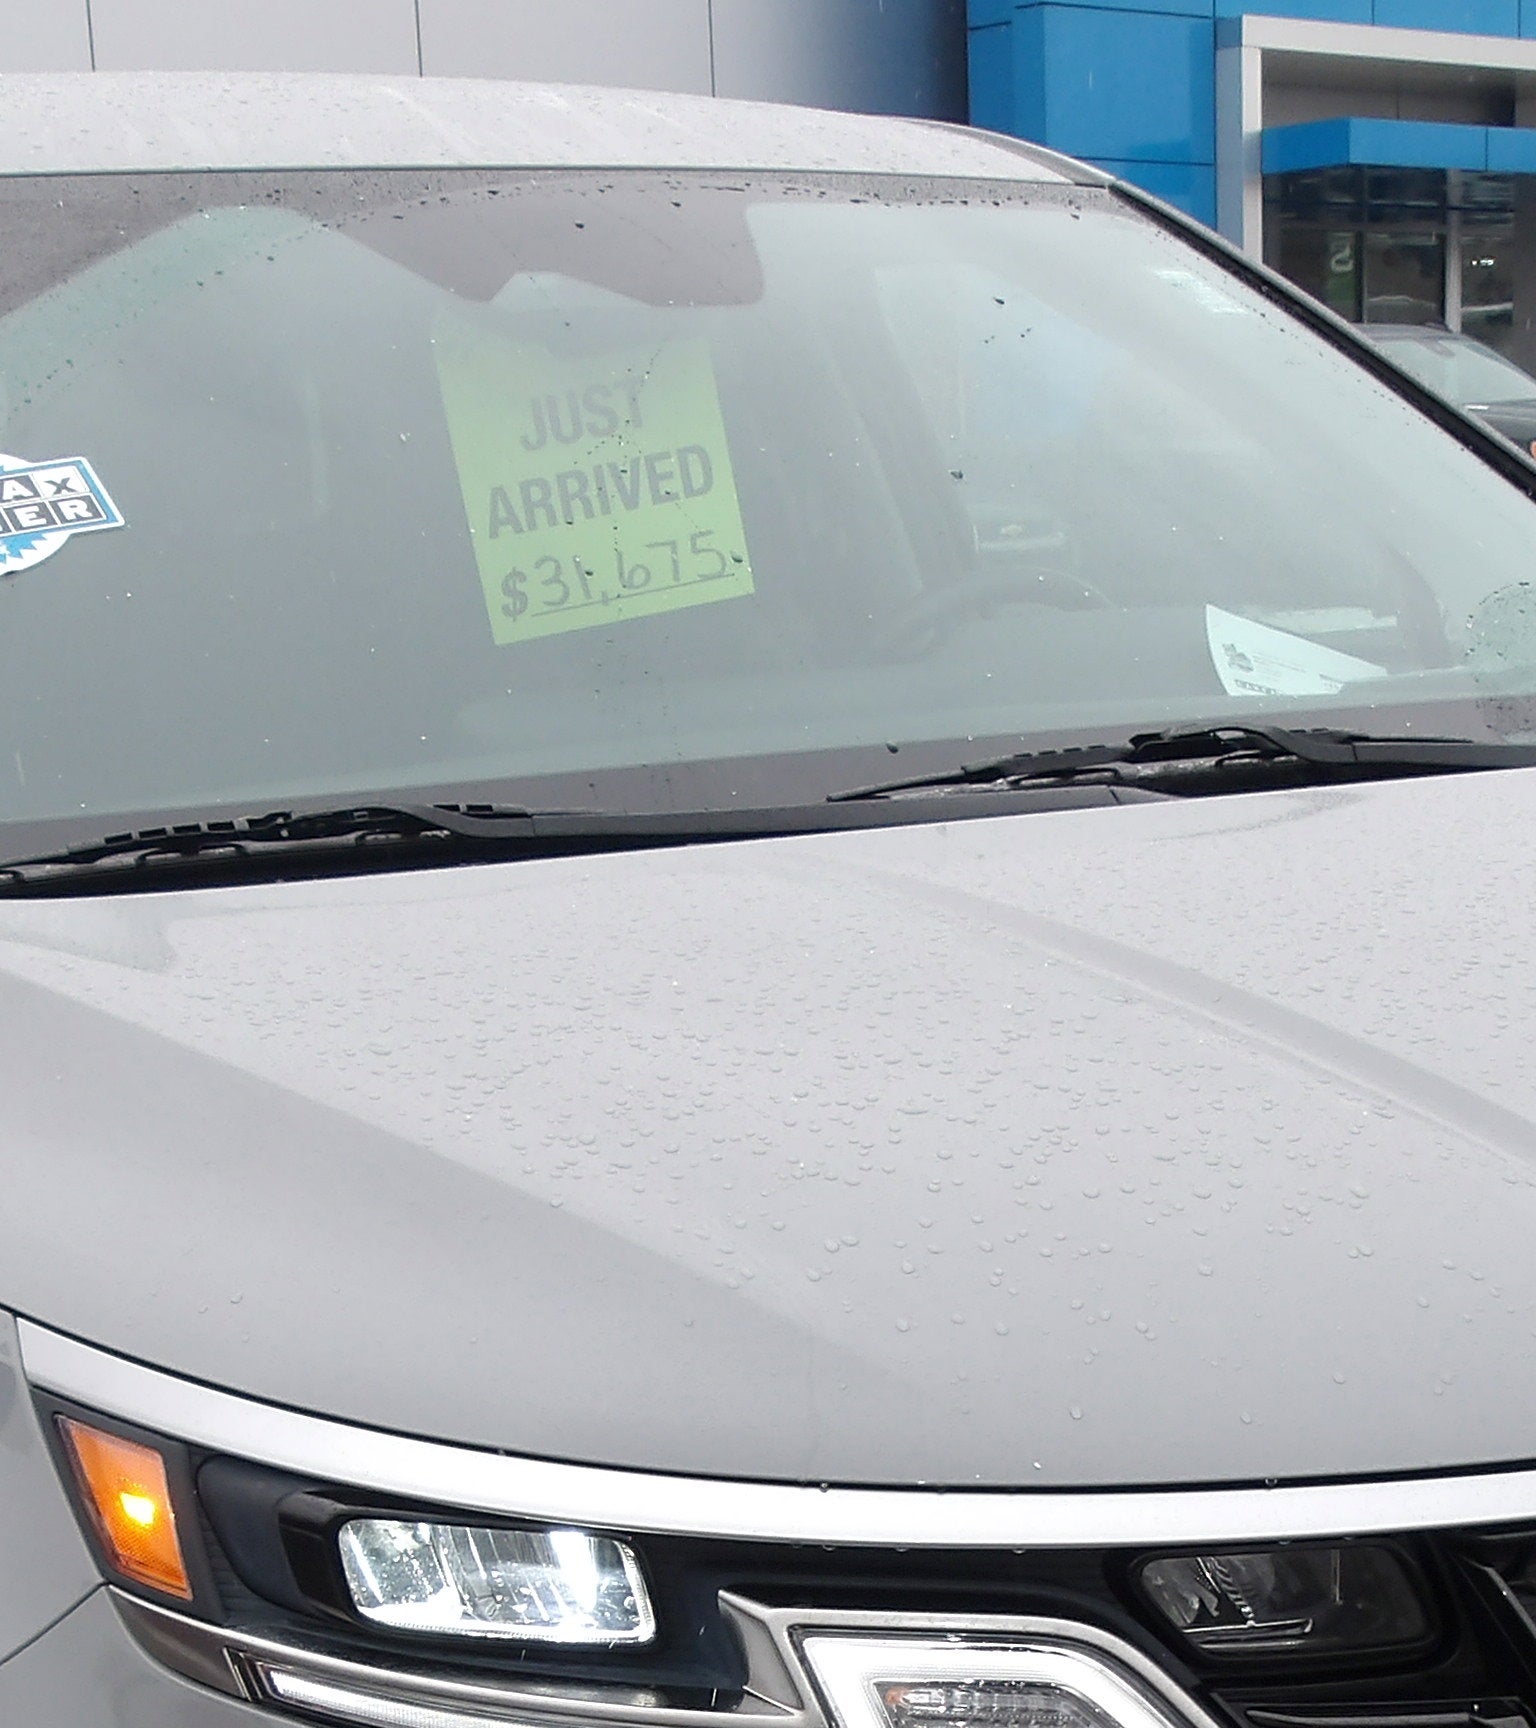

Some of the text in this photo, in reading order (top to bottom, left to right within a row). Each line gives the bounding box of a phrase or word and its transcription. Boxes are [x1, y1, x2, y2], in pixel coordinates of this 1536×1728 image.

[519, 377, 645, 452] JUST
[488, 444, 714, 540] ARRIVED
[501, 530, 728, 622] $31,675
